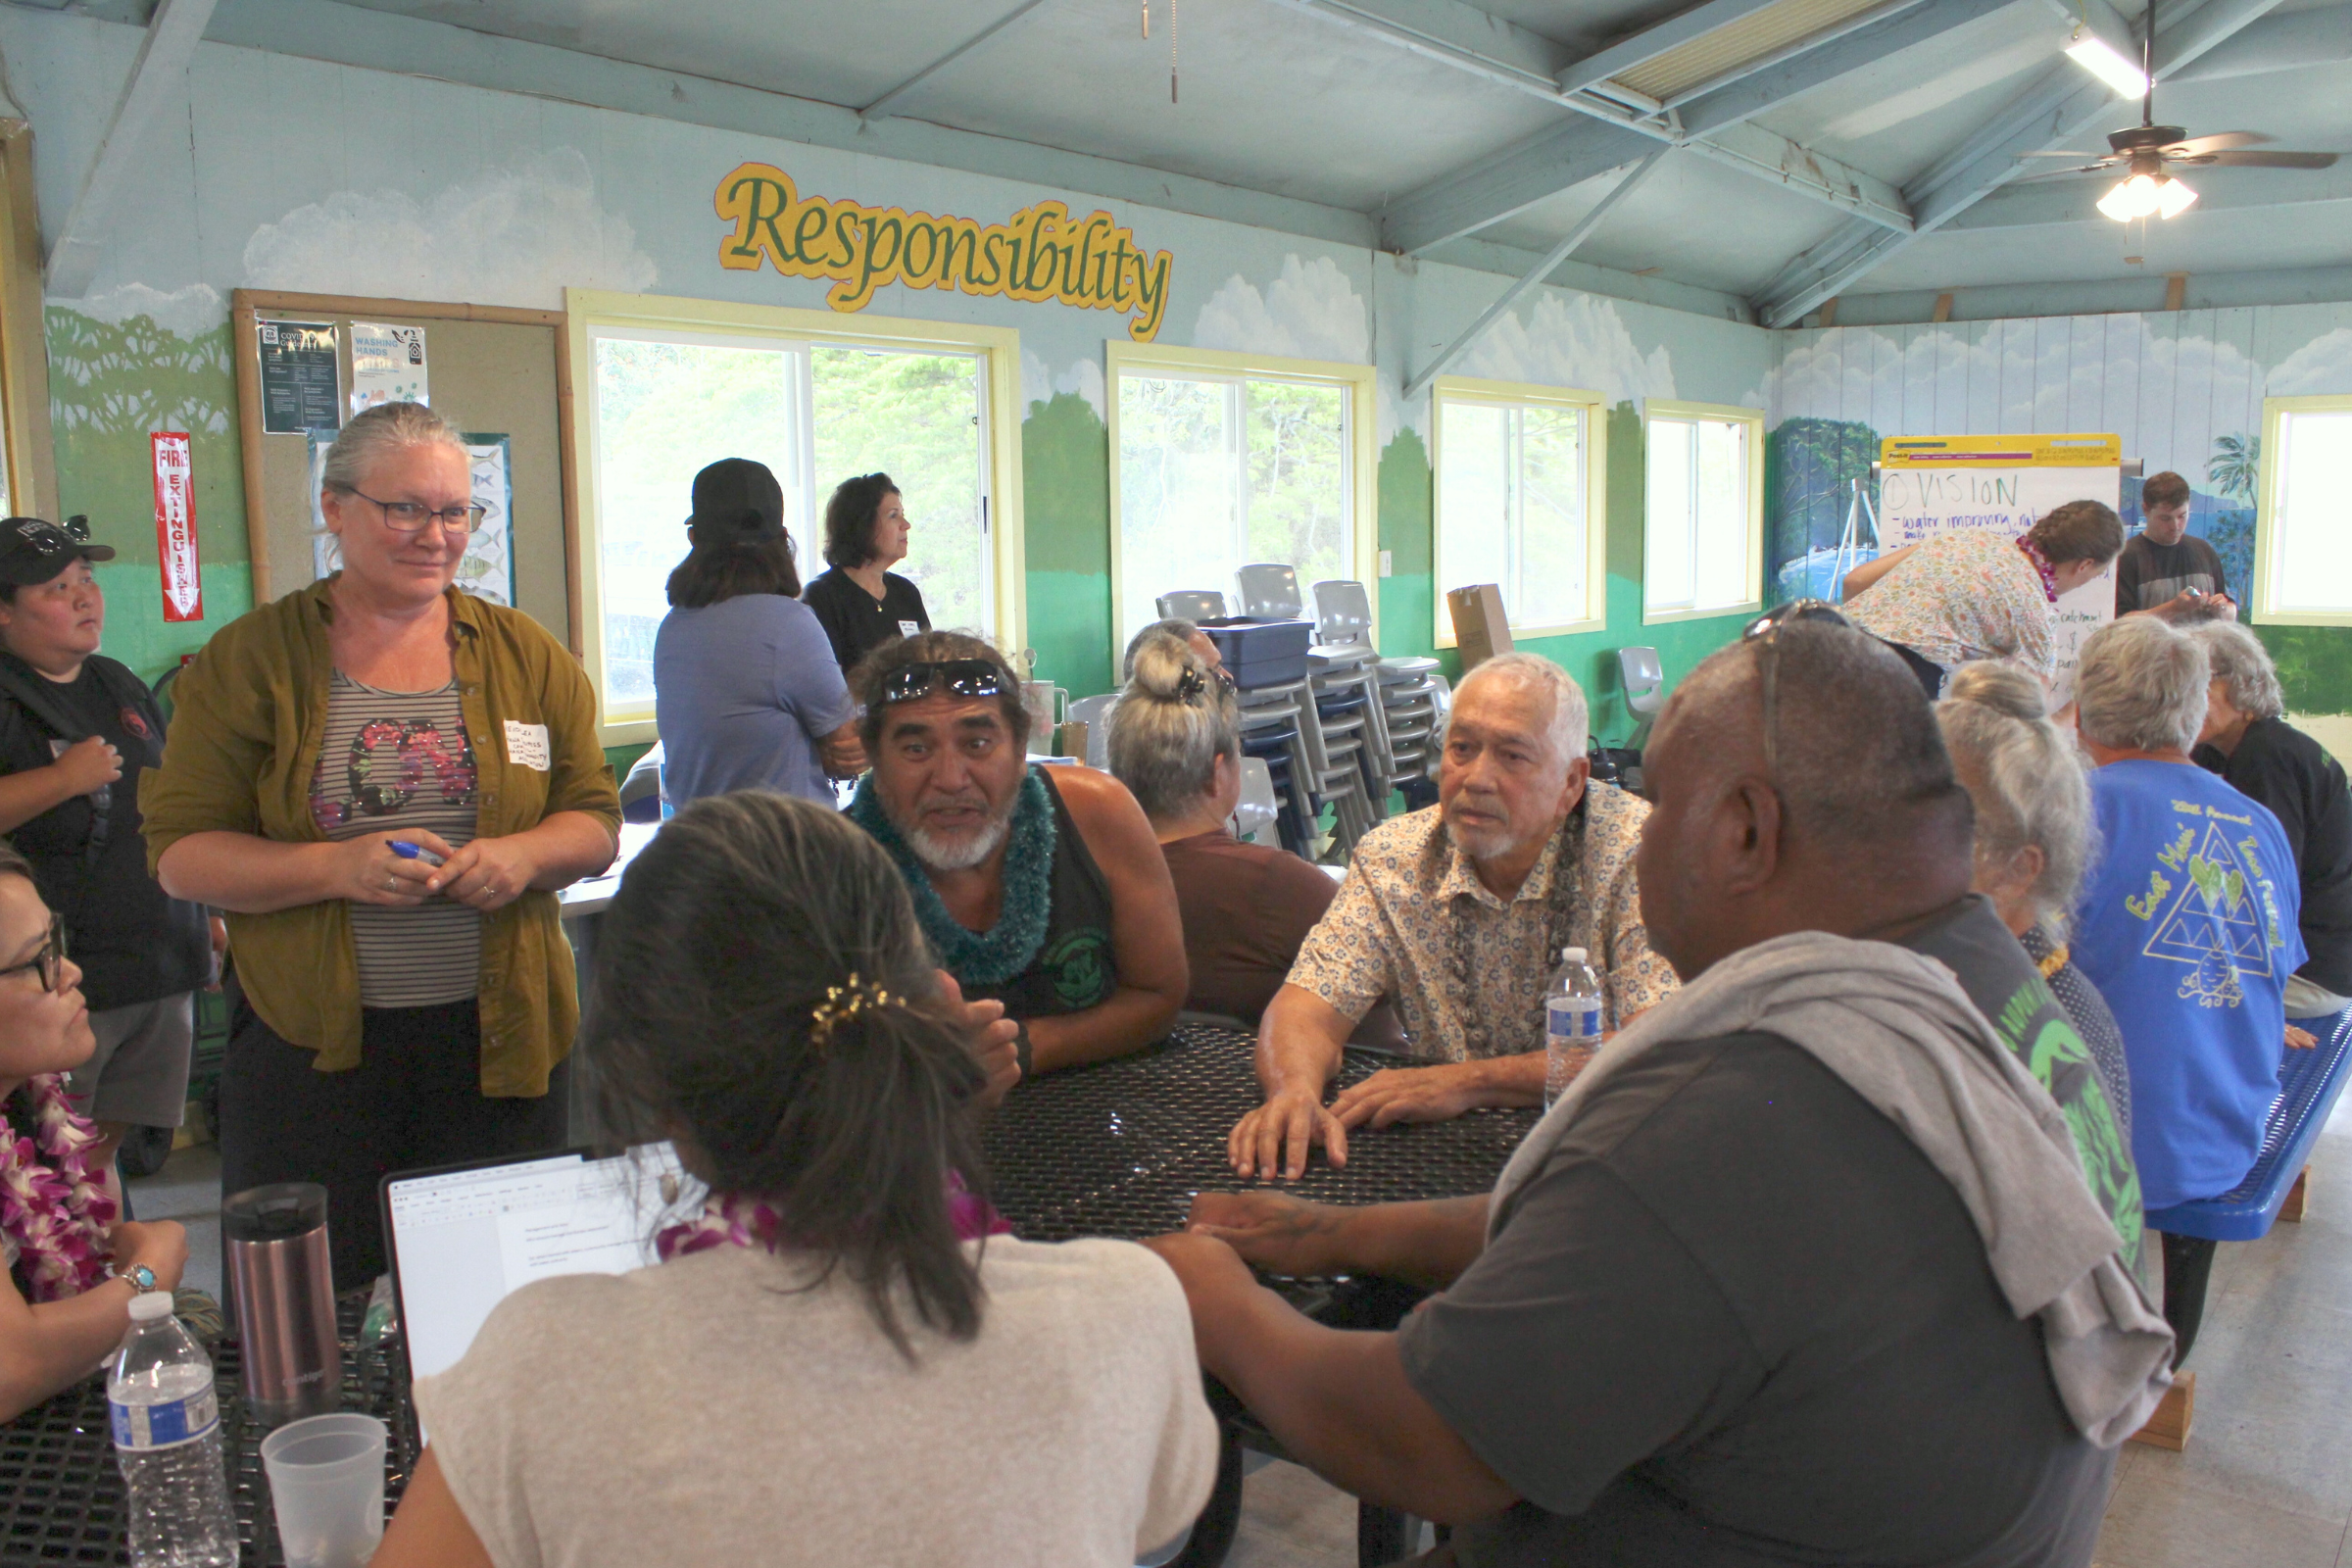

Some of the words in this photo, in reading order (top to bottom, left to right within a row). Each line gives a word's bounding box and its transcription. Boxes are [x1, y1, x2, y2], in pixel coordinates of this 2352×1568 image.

[728, 176, 1167, 334] Responsibility
[355, 337, 399, 348] WASHING
[356, 347, 388, 357] HANDS
[159, 450, 189, 467] FIRE
[1917, 472, 2018, 508] VISION
[169, 473, 189, 607] EXTINGUISHER
[2157, 822, 2196, 872] Maui
[2237, 836, 2263, 878] Taro
